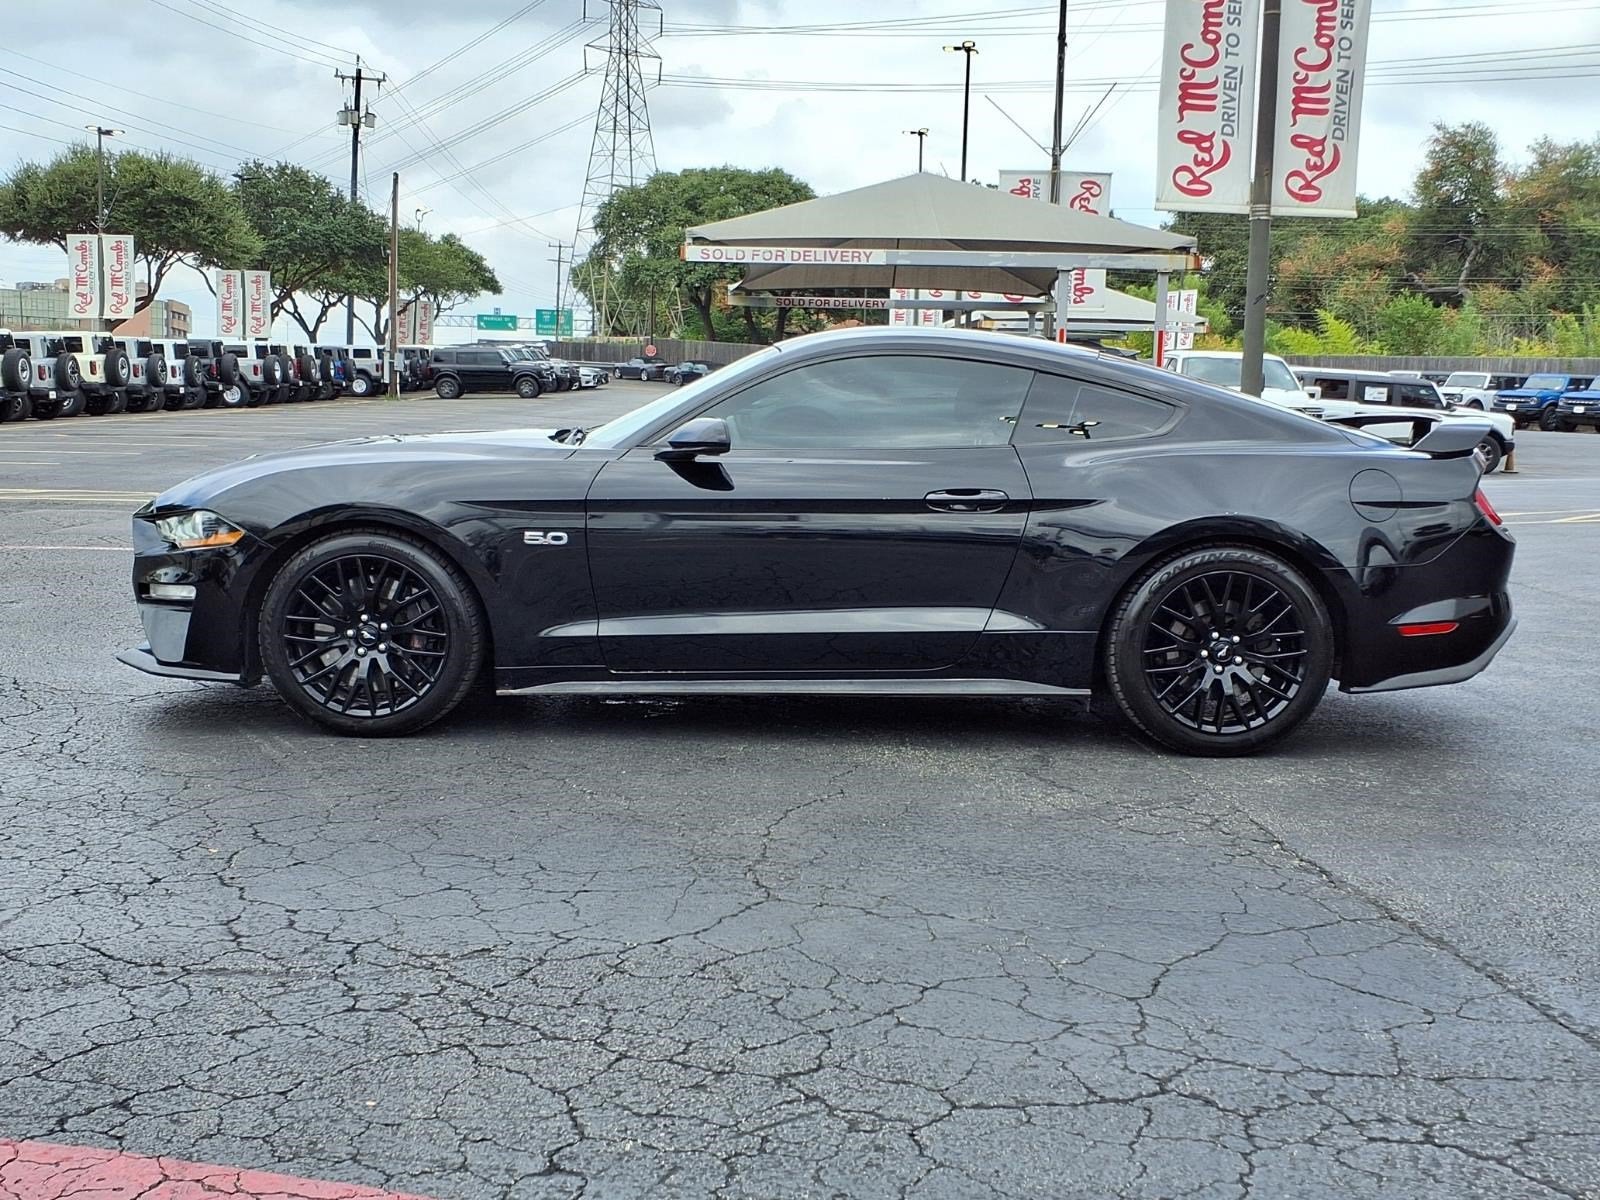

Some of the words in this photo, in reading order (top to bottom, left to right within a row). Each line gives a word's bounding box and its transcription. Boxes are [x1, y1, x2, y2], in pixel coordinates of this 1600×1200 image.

[1225, 33, 1240, 58] TO
[1337, 37, 1353, 62] TO
[1221, 65, 1239, 138] DRIVEN
[1332, 69, 1351, 141] DRIVEN
[1173, 130, 1231, 197] Red
[1285, 134, 1341, 202] Red
[1070, 180, 1102, 215] Red
[74, 240, 89, 290] McCombs
[110, 240, 124, 290] McCombs
[700, 248, 746, 261] SOLD
[751, 249, 785, 262] FOR
[790, 250, 873, 263] DELIVERY
[73, 292, 93, 314] Red
[109, 292, 129, 314] Red
[250, 275, 262, 315] McCombs
[775, 297, 805, 307] SOLD
[808, 298, 831, 308] FOR
[833, 299, 886, 308] DELIVERY
[524, 531, 568, 545] 5.0
[1149, 551, 1289, 594] CONTINENTAL
